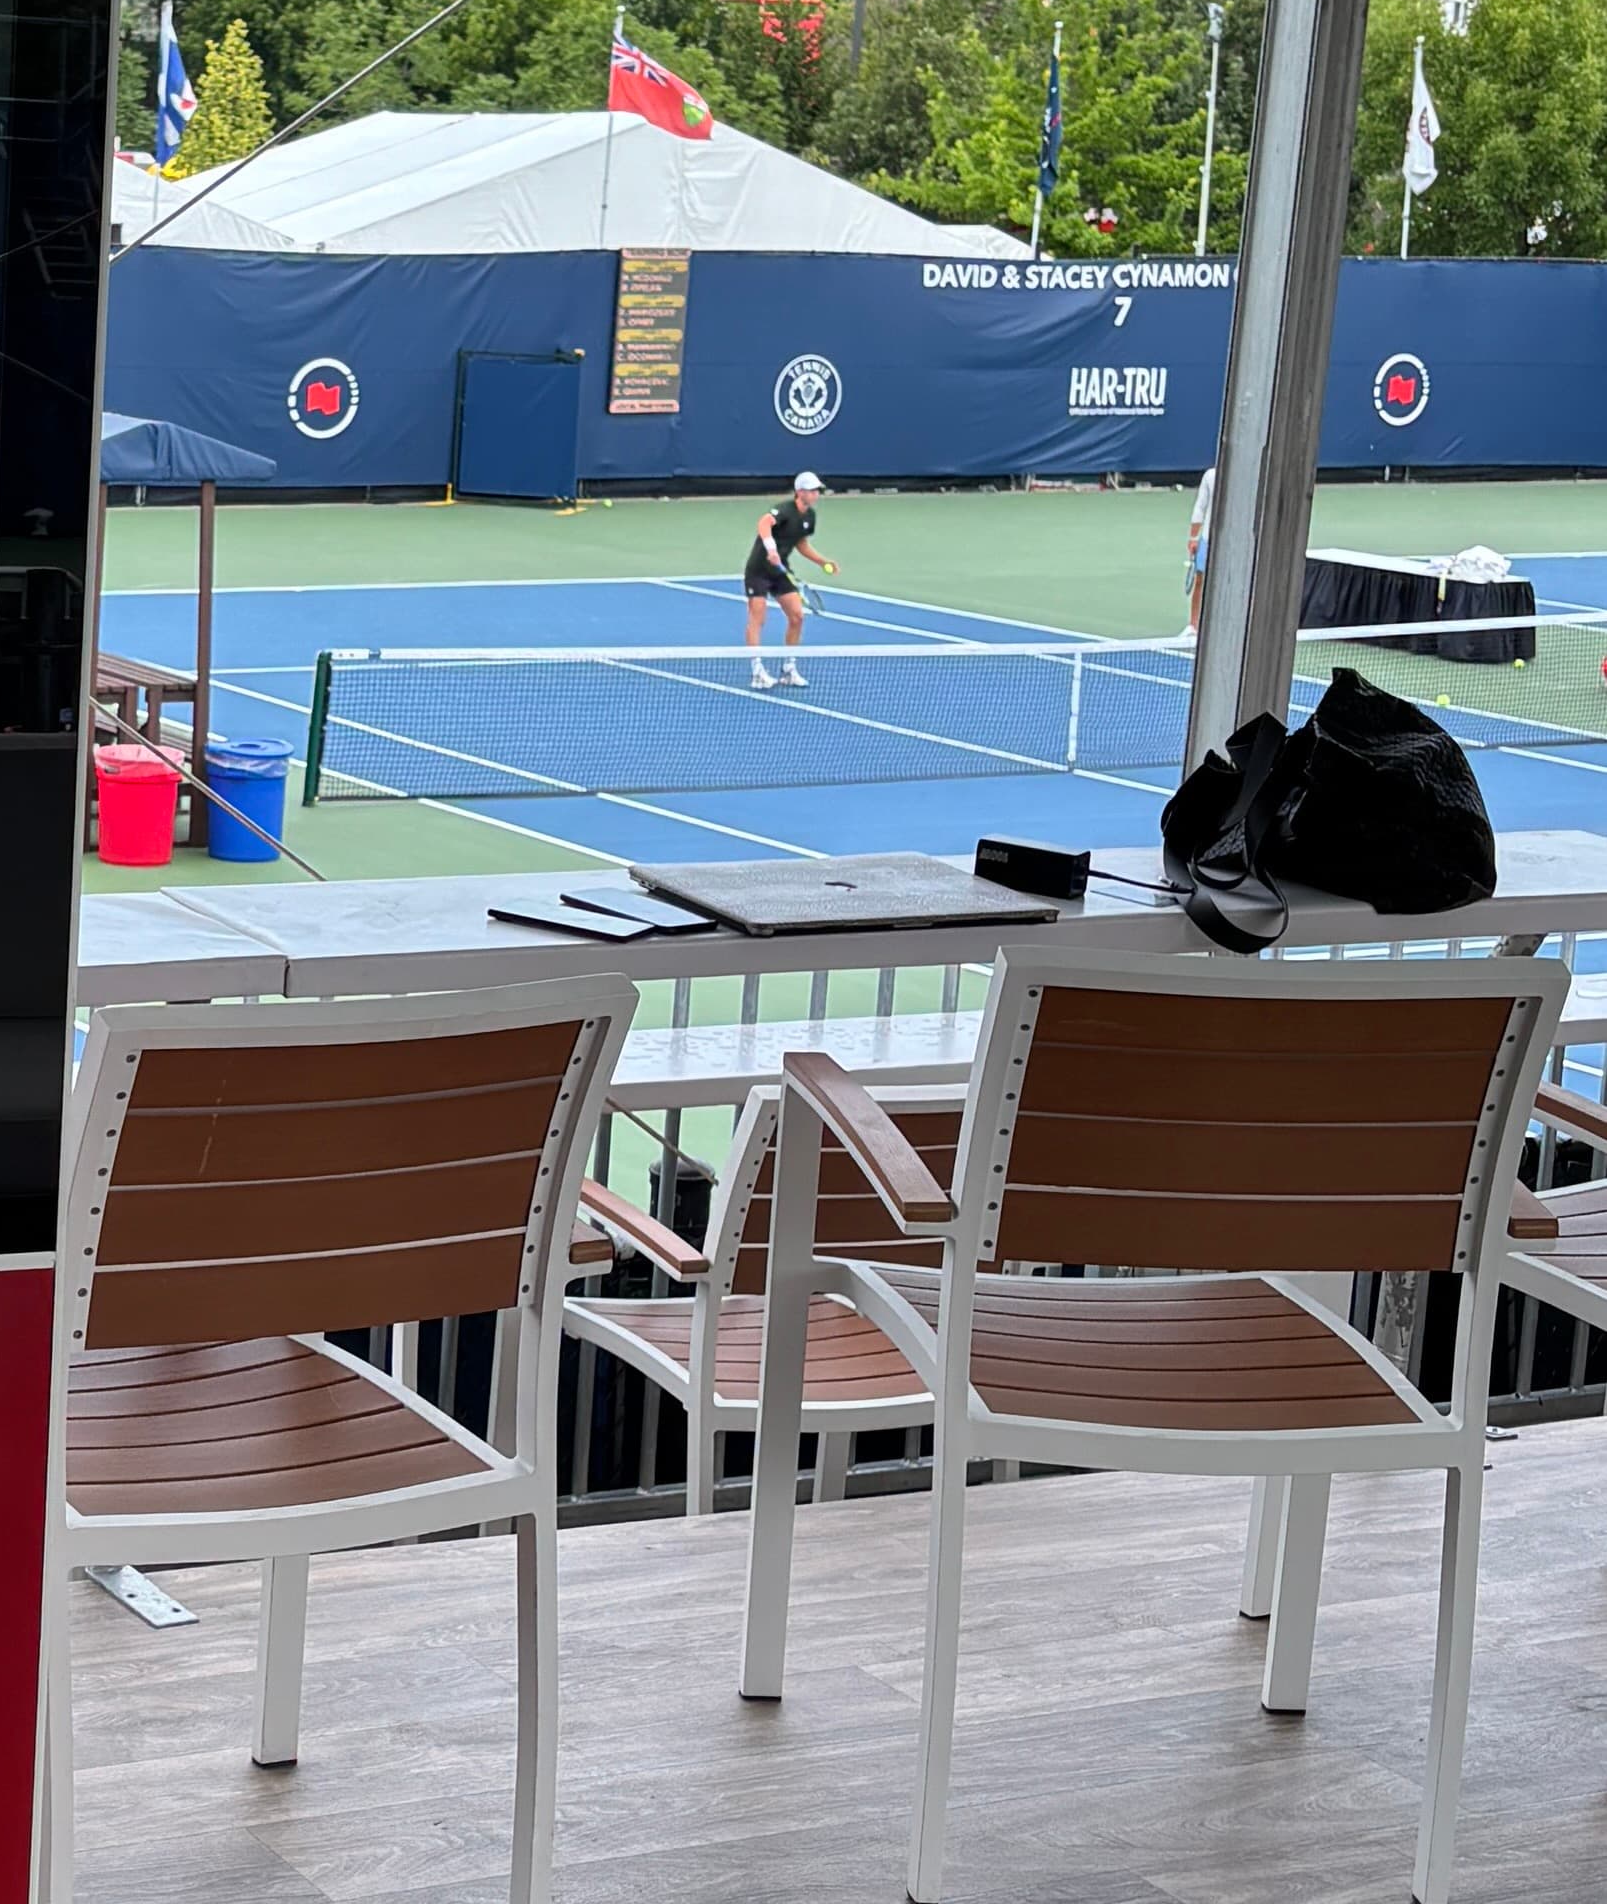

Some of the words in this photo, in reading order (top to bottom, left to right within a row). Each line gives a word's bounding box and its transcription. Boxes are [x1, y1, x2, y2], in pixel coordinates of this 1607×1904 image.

[923, 263, 998, 288] DAVID
[1001, 265, 1021, 289] &
[1025, 265, 1109, 289] STACEY
[1112, 263, 1230, 288] CYNAMON
[1114, 296, 1132, 327] 7
[787, 361, 832, 381] TENNIS
[1069, 367, 1168, 407] HAR-TRU
[783, 408, 831, 429] CANADA
